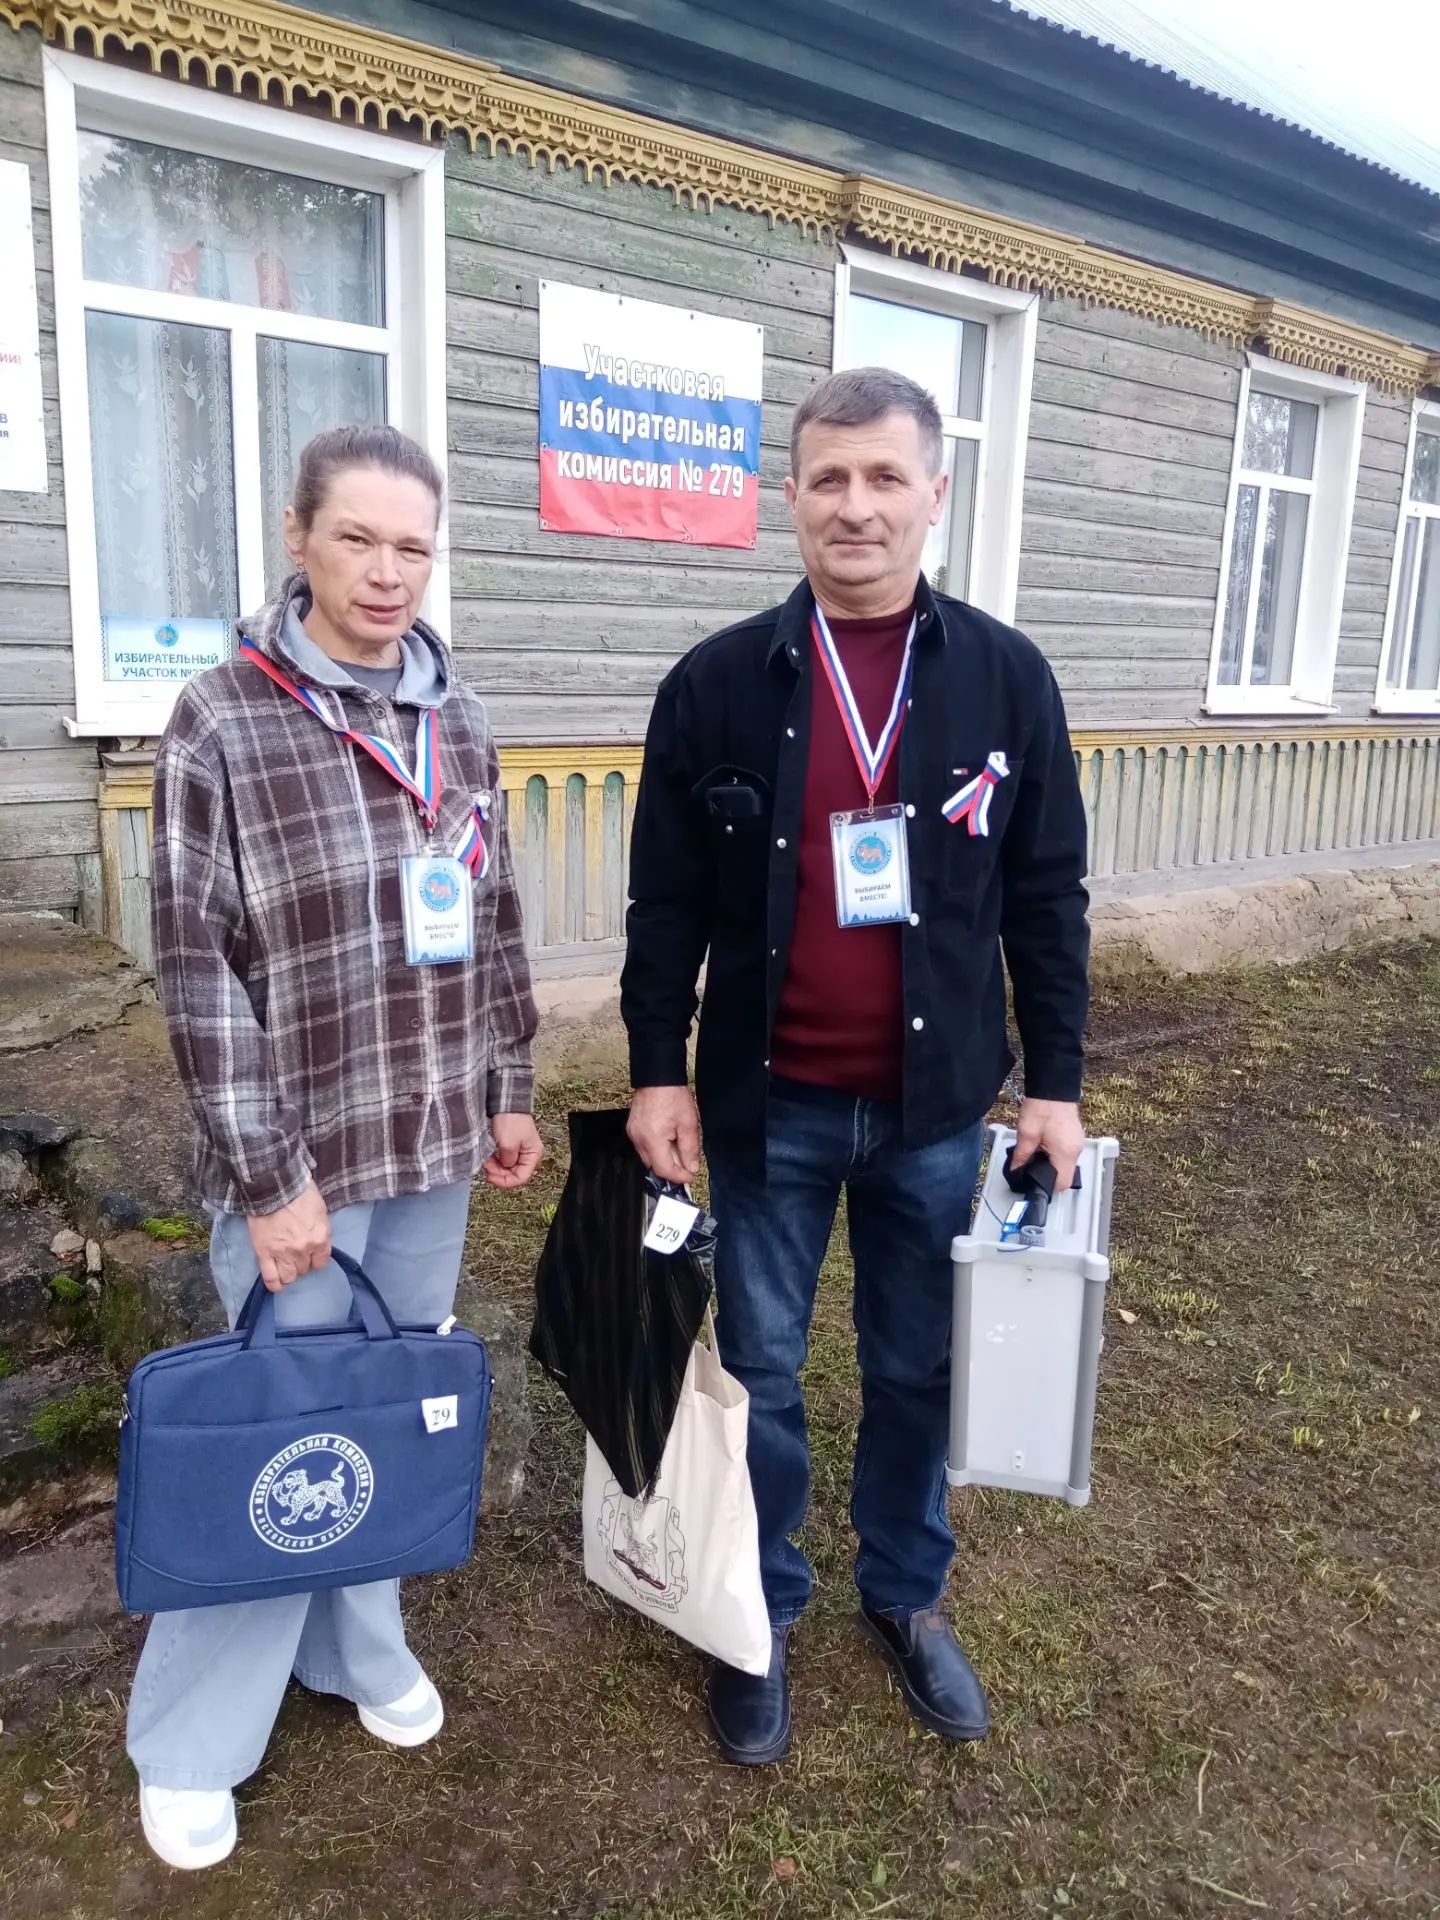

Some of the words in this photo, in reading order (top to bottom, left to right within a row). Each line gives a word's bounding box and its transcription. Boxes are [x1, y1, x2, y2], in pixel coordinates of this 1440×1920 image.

[583, 343, 725, 402] Участковая
[559, 396, 745, 452] избирательная
[557, 451, 673, 490] комиссия
[678, 458, 703, 493] №
[708, 464, 744, 498] 279
[114, 652, 219, 664] ИЗБИРАТЕЛЬНЫЙ
[122, 667, 178, 678] УЧАСТОК
[656, 1223, 681, 1244] 279
[254, 1438, 329, 1505] ИЗБИРАТЕЛЬНАЯ
[332, 1439, 369, 1488] КОМИССИЯ
